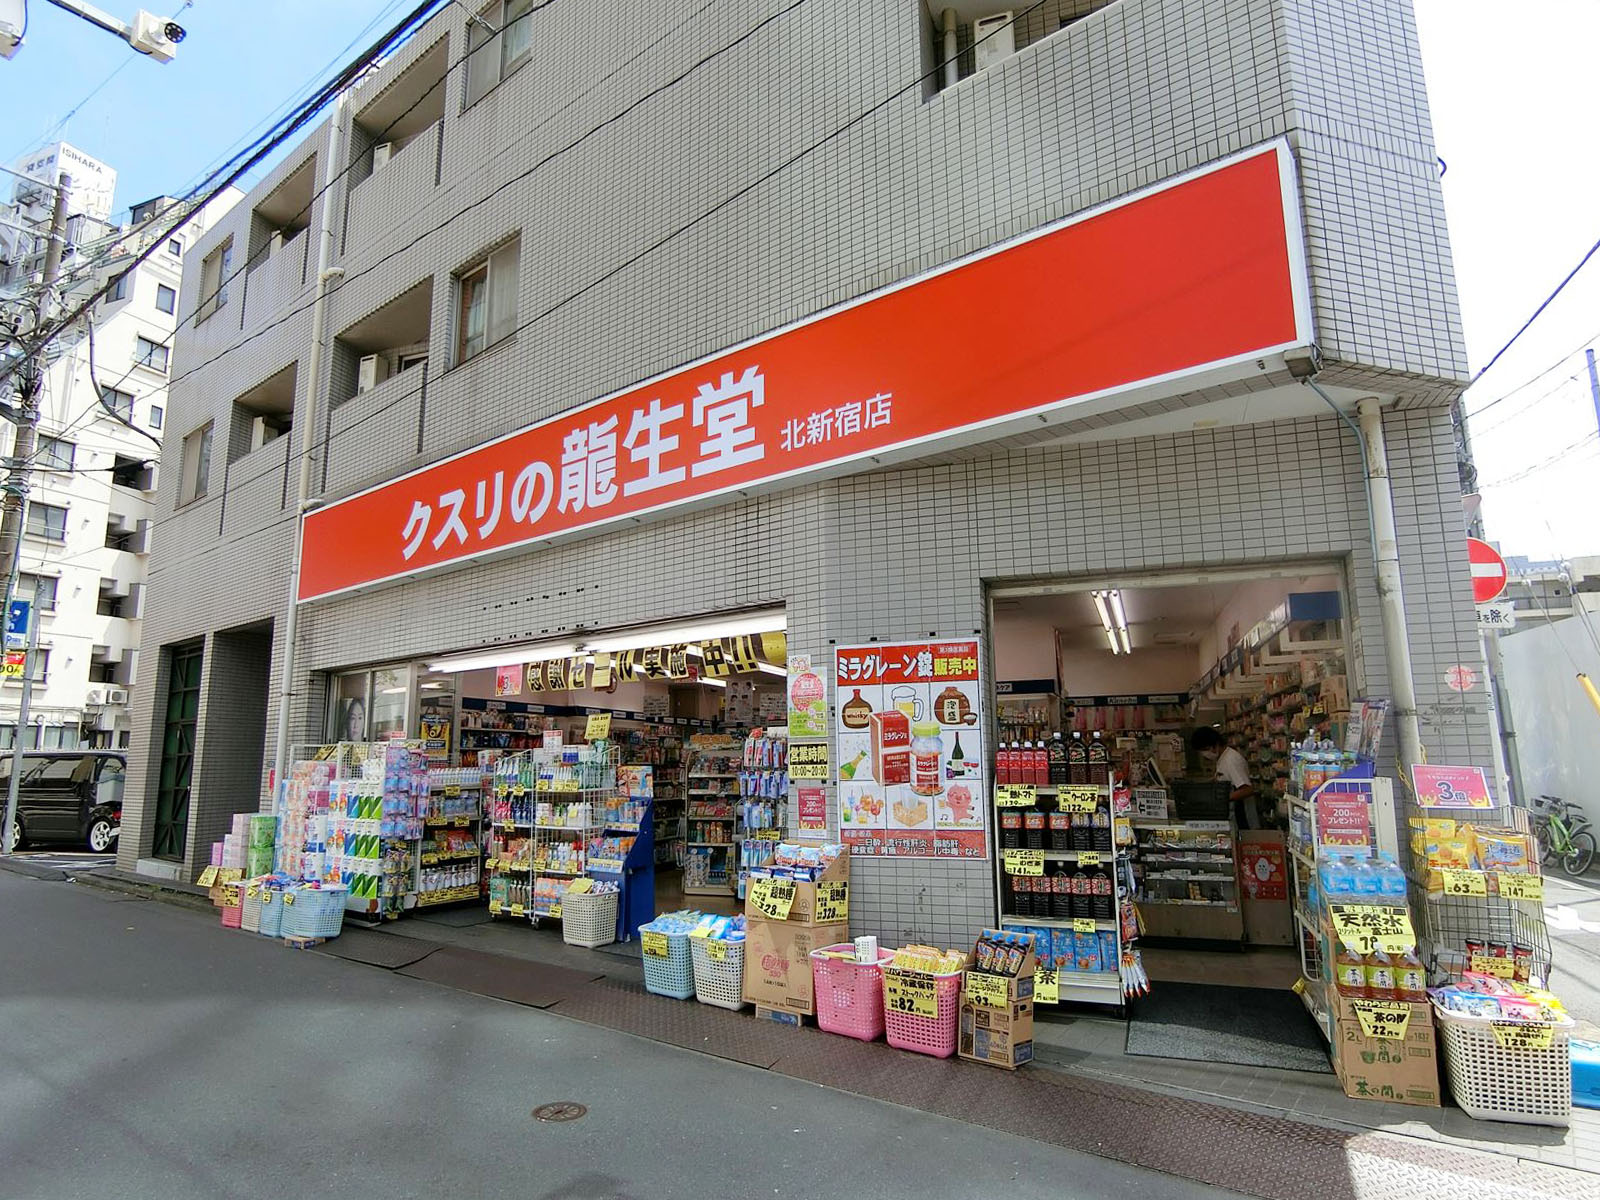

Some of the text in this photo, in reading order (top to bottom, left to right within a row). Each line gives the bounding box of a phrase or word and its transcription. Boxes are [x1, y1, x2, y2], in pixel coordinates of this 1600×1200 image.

[62, 147, 102, 174] ISIHARA
[401, 364, 893, 561] クスリの龍生堂 北新宿店
[838, 651, 977, 681] ミラグレーン錠 販売中
[790, 746, 828, 763] 営業時間
[1333, 808, 1350, 817] 200
[1453, 883, 1471, 894] 63
[1507, 887, 1525, 898] 147
[822, 907, 836, 919] 328
[1338, 913, 1404, 927] 天然水
[1371, 927, 1404, 936] 富士山
[898, 997, 915, 1012] 82
[975, 995, 988, 1006] 93
[1504, 1037, 1527, 1047] 128
